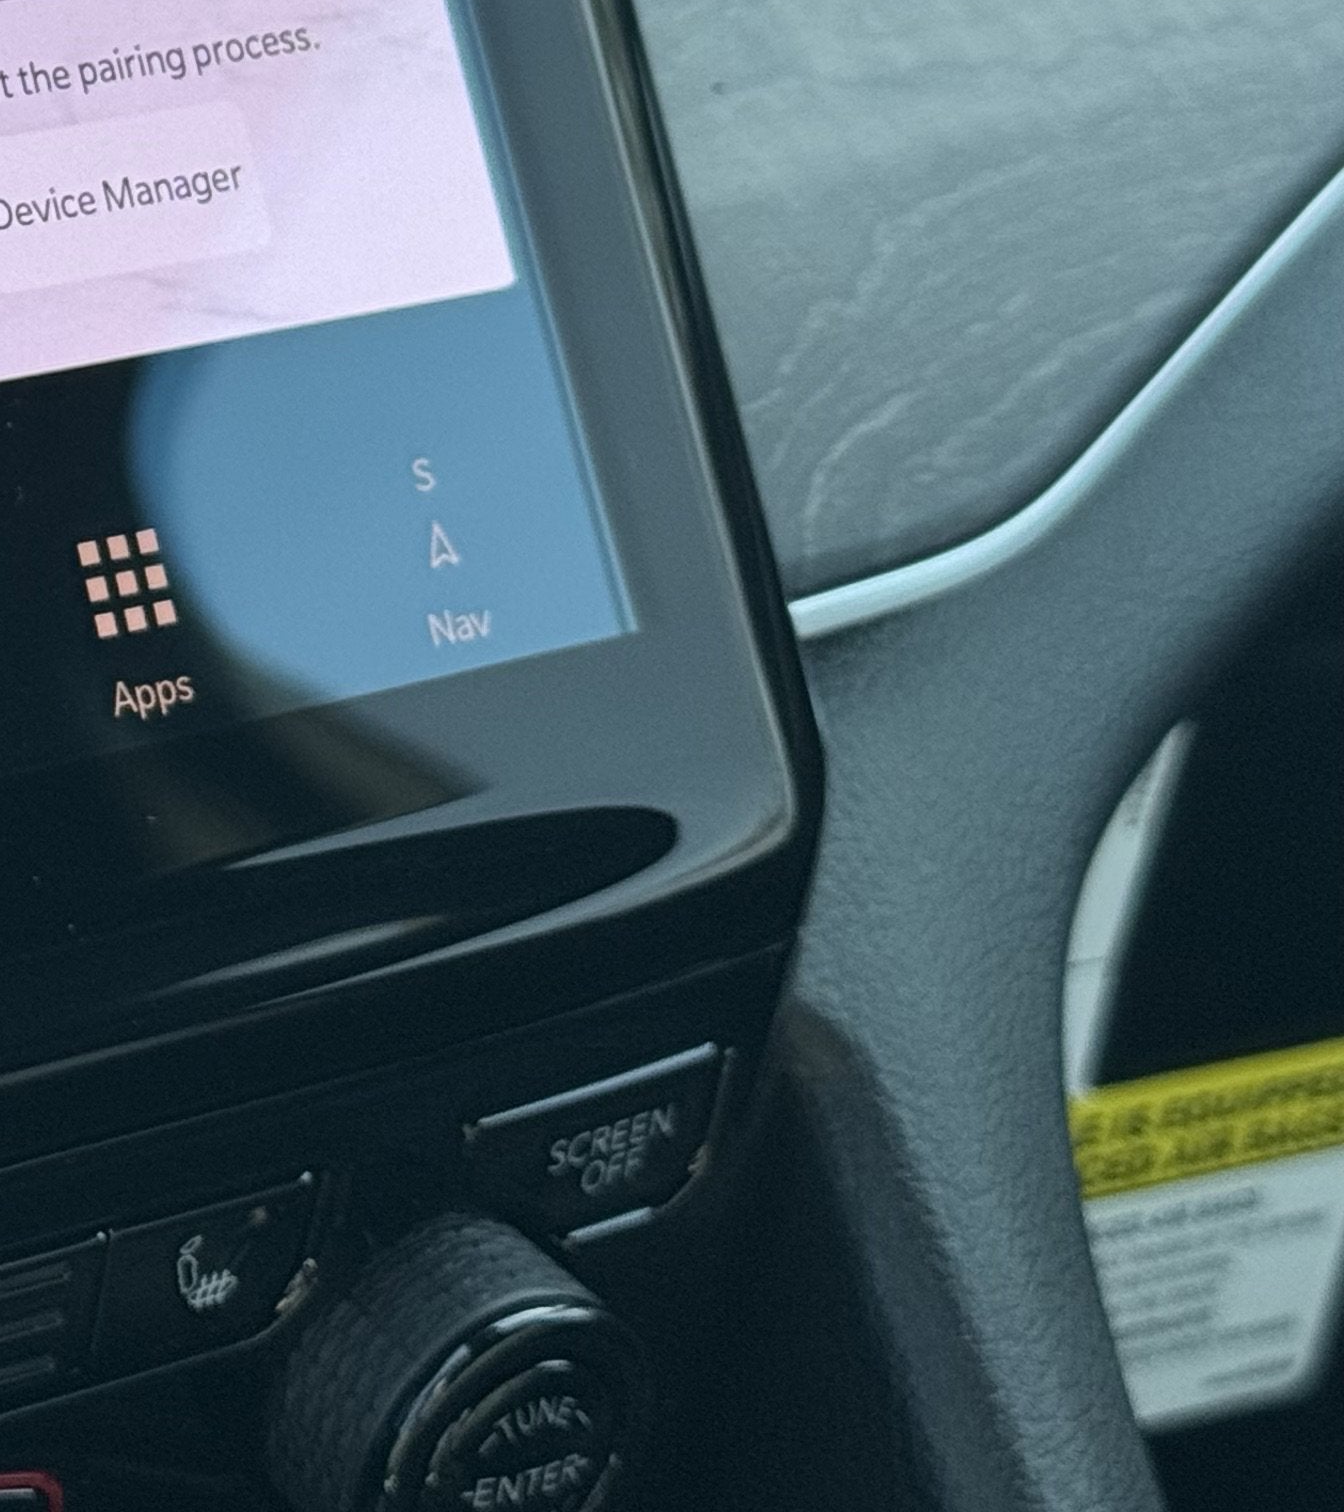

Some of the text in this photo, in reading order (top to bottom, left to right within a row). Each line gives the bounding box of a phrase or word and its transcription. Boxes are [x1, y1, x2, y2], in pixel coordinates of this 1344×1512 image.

[18, 59, 72, 98] the
[78, 45, 187, 94] pairing
[193, 24, 321, 74] process.
[102, 160, 245, 215] Manager
[411, 458, 435, 492] S
[427, 609, 492, 646] Nav
[112, 673, 195, 720] Apps
[547, 1103, 677, 1177] SCREEN
[581, 1144, 645, 1195] OFF
[495, 1395, 577, 1443] TUNE
[472, 1453, 588, 1510] ENTER
